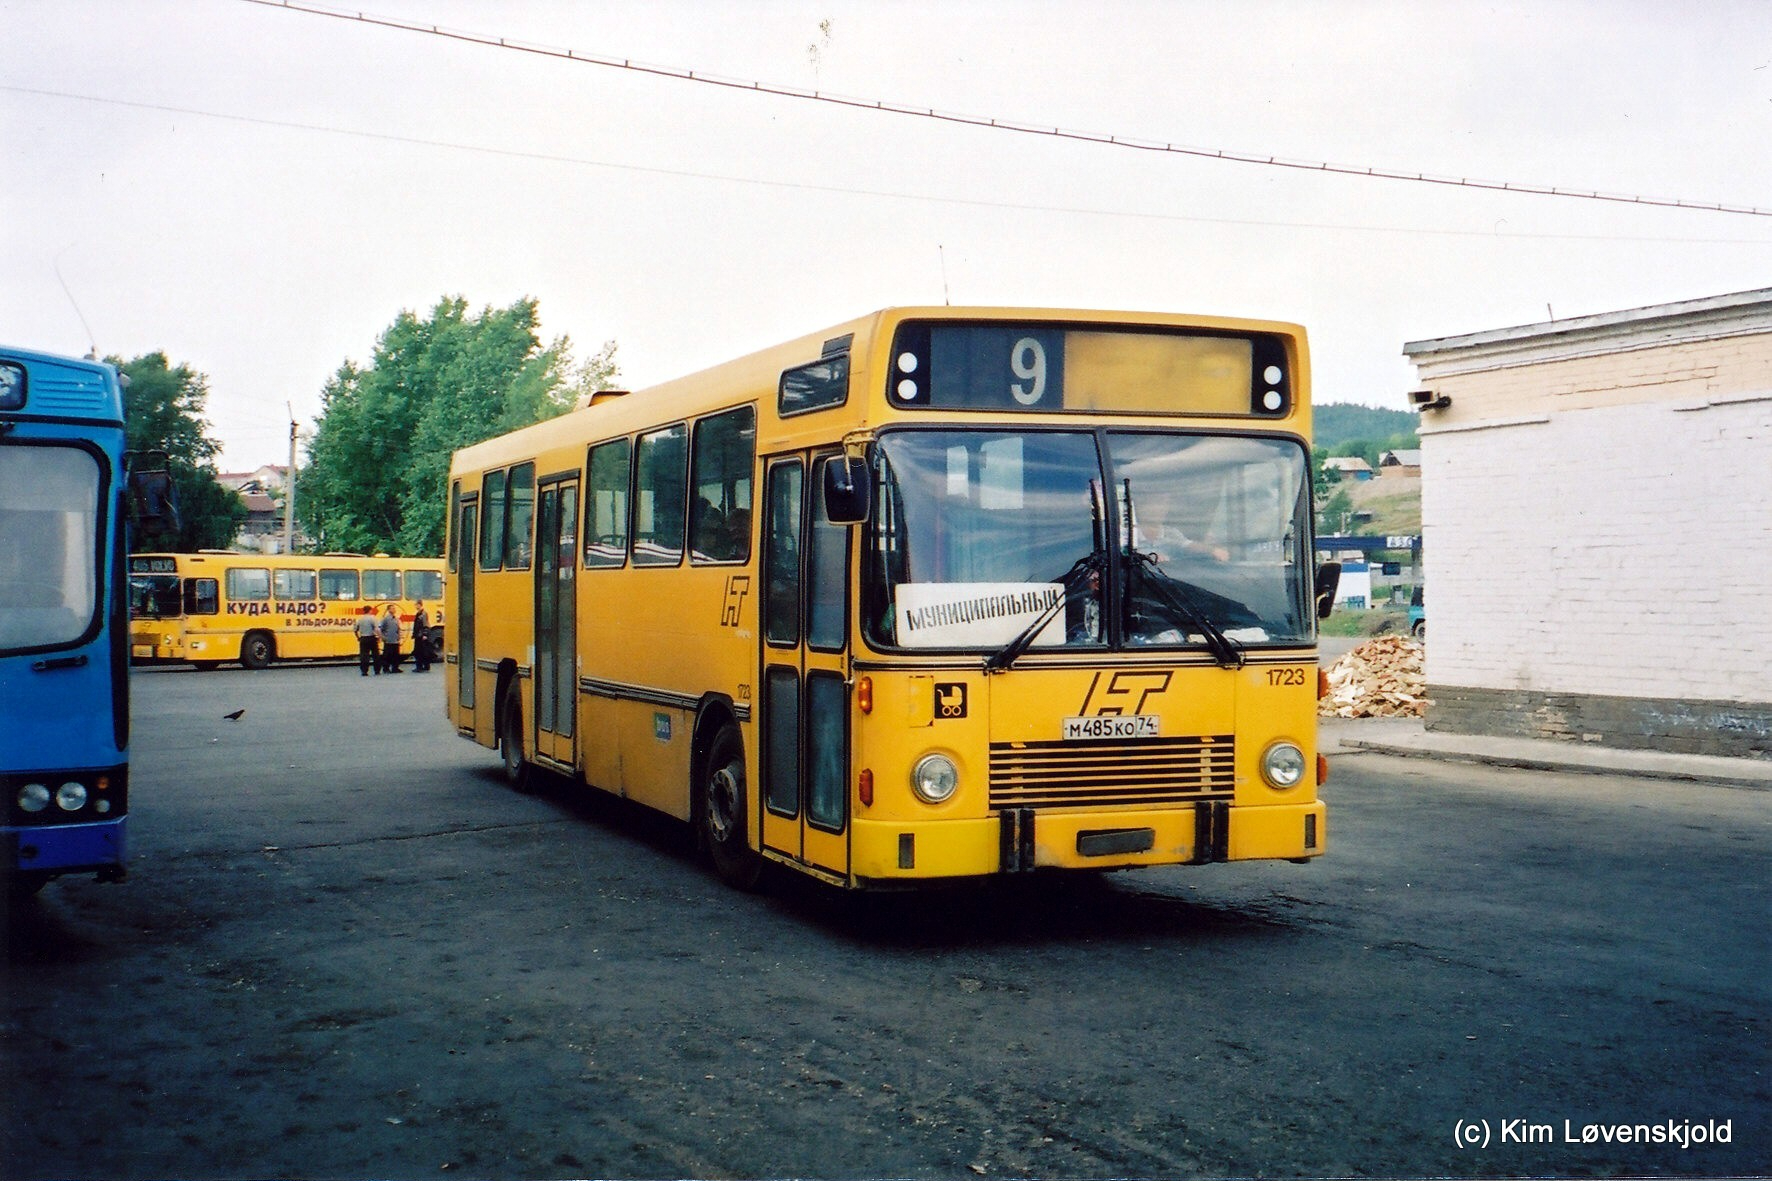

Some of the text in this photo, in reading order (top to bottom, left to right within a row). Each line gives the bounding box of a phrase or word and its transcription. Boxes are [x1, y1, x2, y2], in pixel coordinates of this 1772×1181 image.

[1010, 337, 1047, 405] 9
[226, 602, 327, 616] КУДА НАДО?
[905, 586, 1060, 632] МУНИЦИПАЛЬНЫЙ
[286, 618, 292, 627] В
[1266, 668, 1305, 686] 1723
